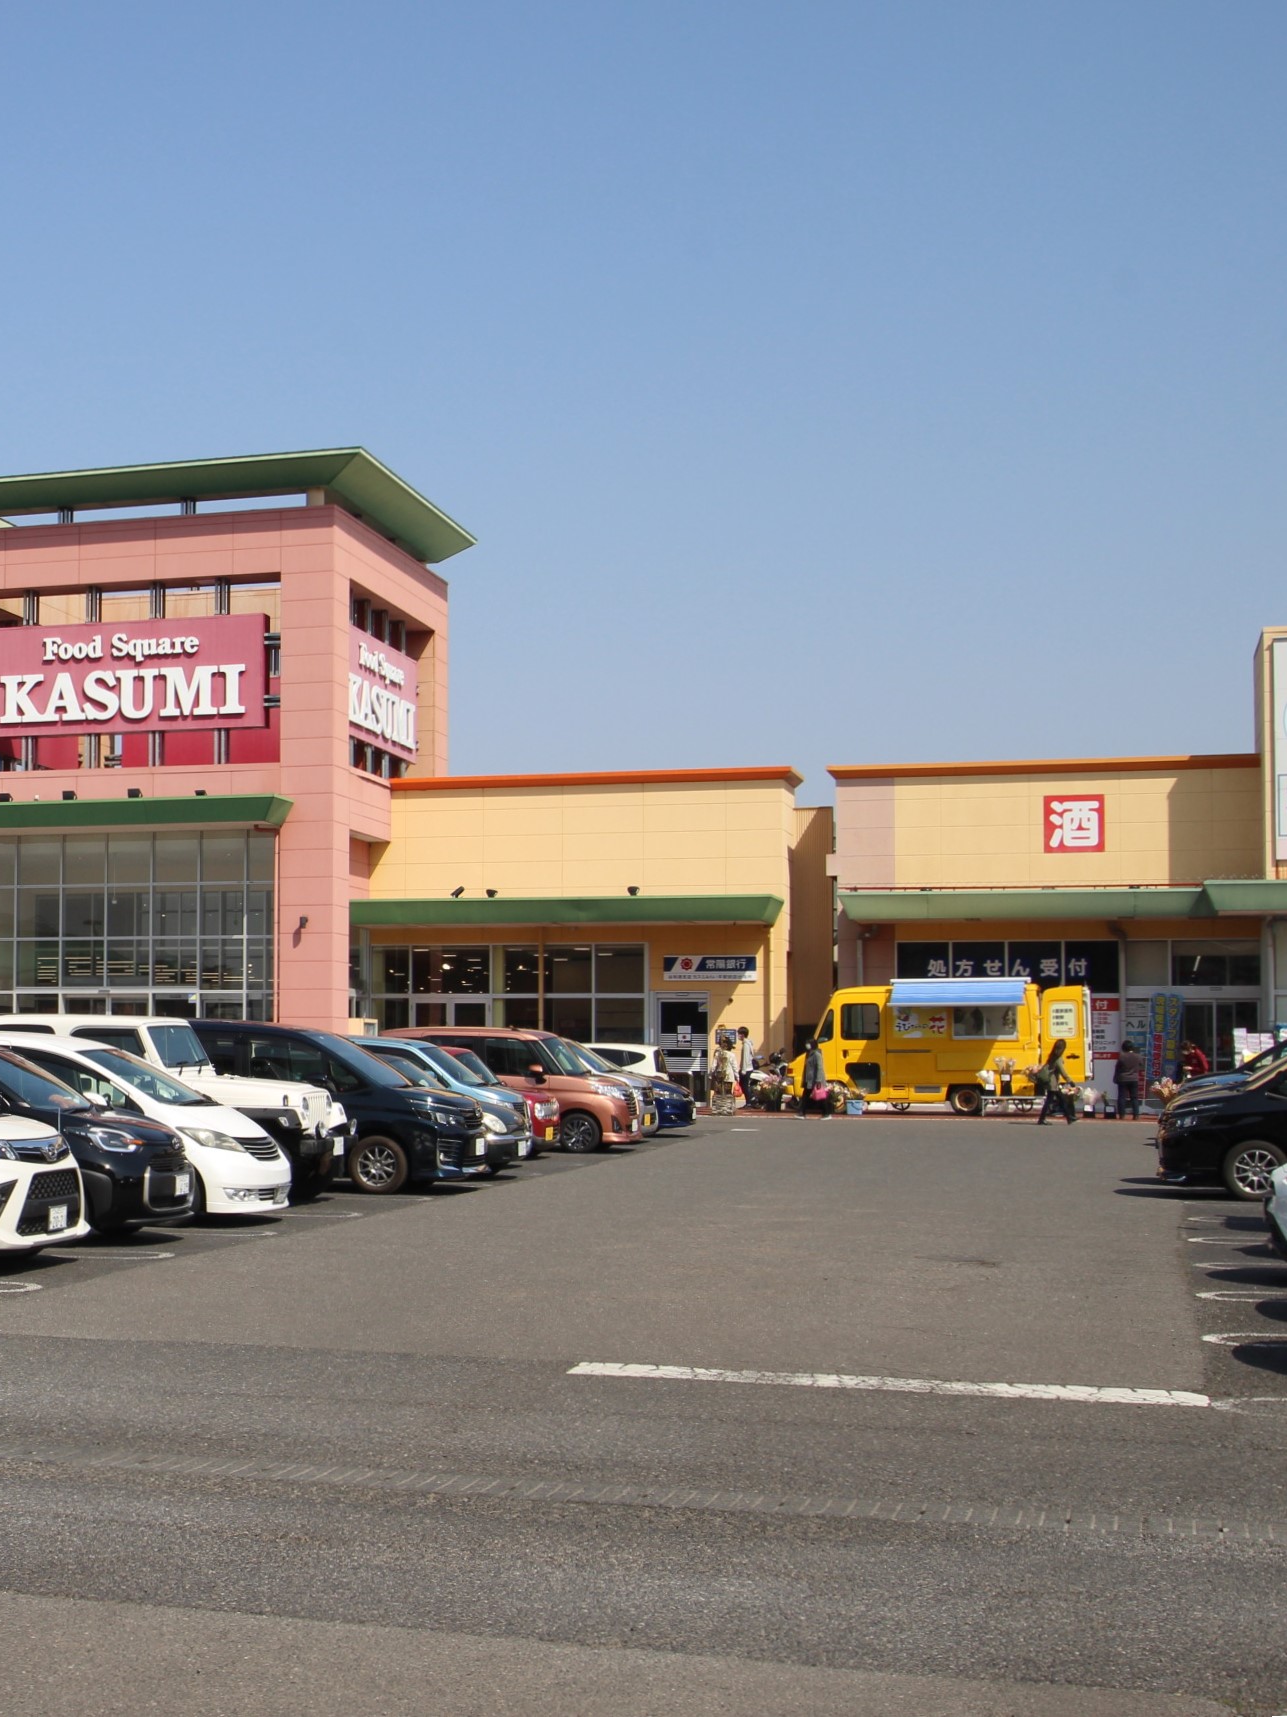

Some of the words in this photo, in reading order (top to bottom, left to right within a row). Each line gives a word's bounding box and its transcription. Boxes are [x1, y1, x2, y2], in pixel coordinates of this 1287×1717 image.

[43, 635, 103, 661] Food
[112, 633, 199, 662] Square
[0, 663, 246, 724] KASUMI
[348, 671, 416, 750] KASUMI
[1049, 800, 1099, 848] 酒
[927, 957, 1088, 977] 処方せん受付
